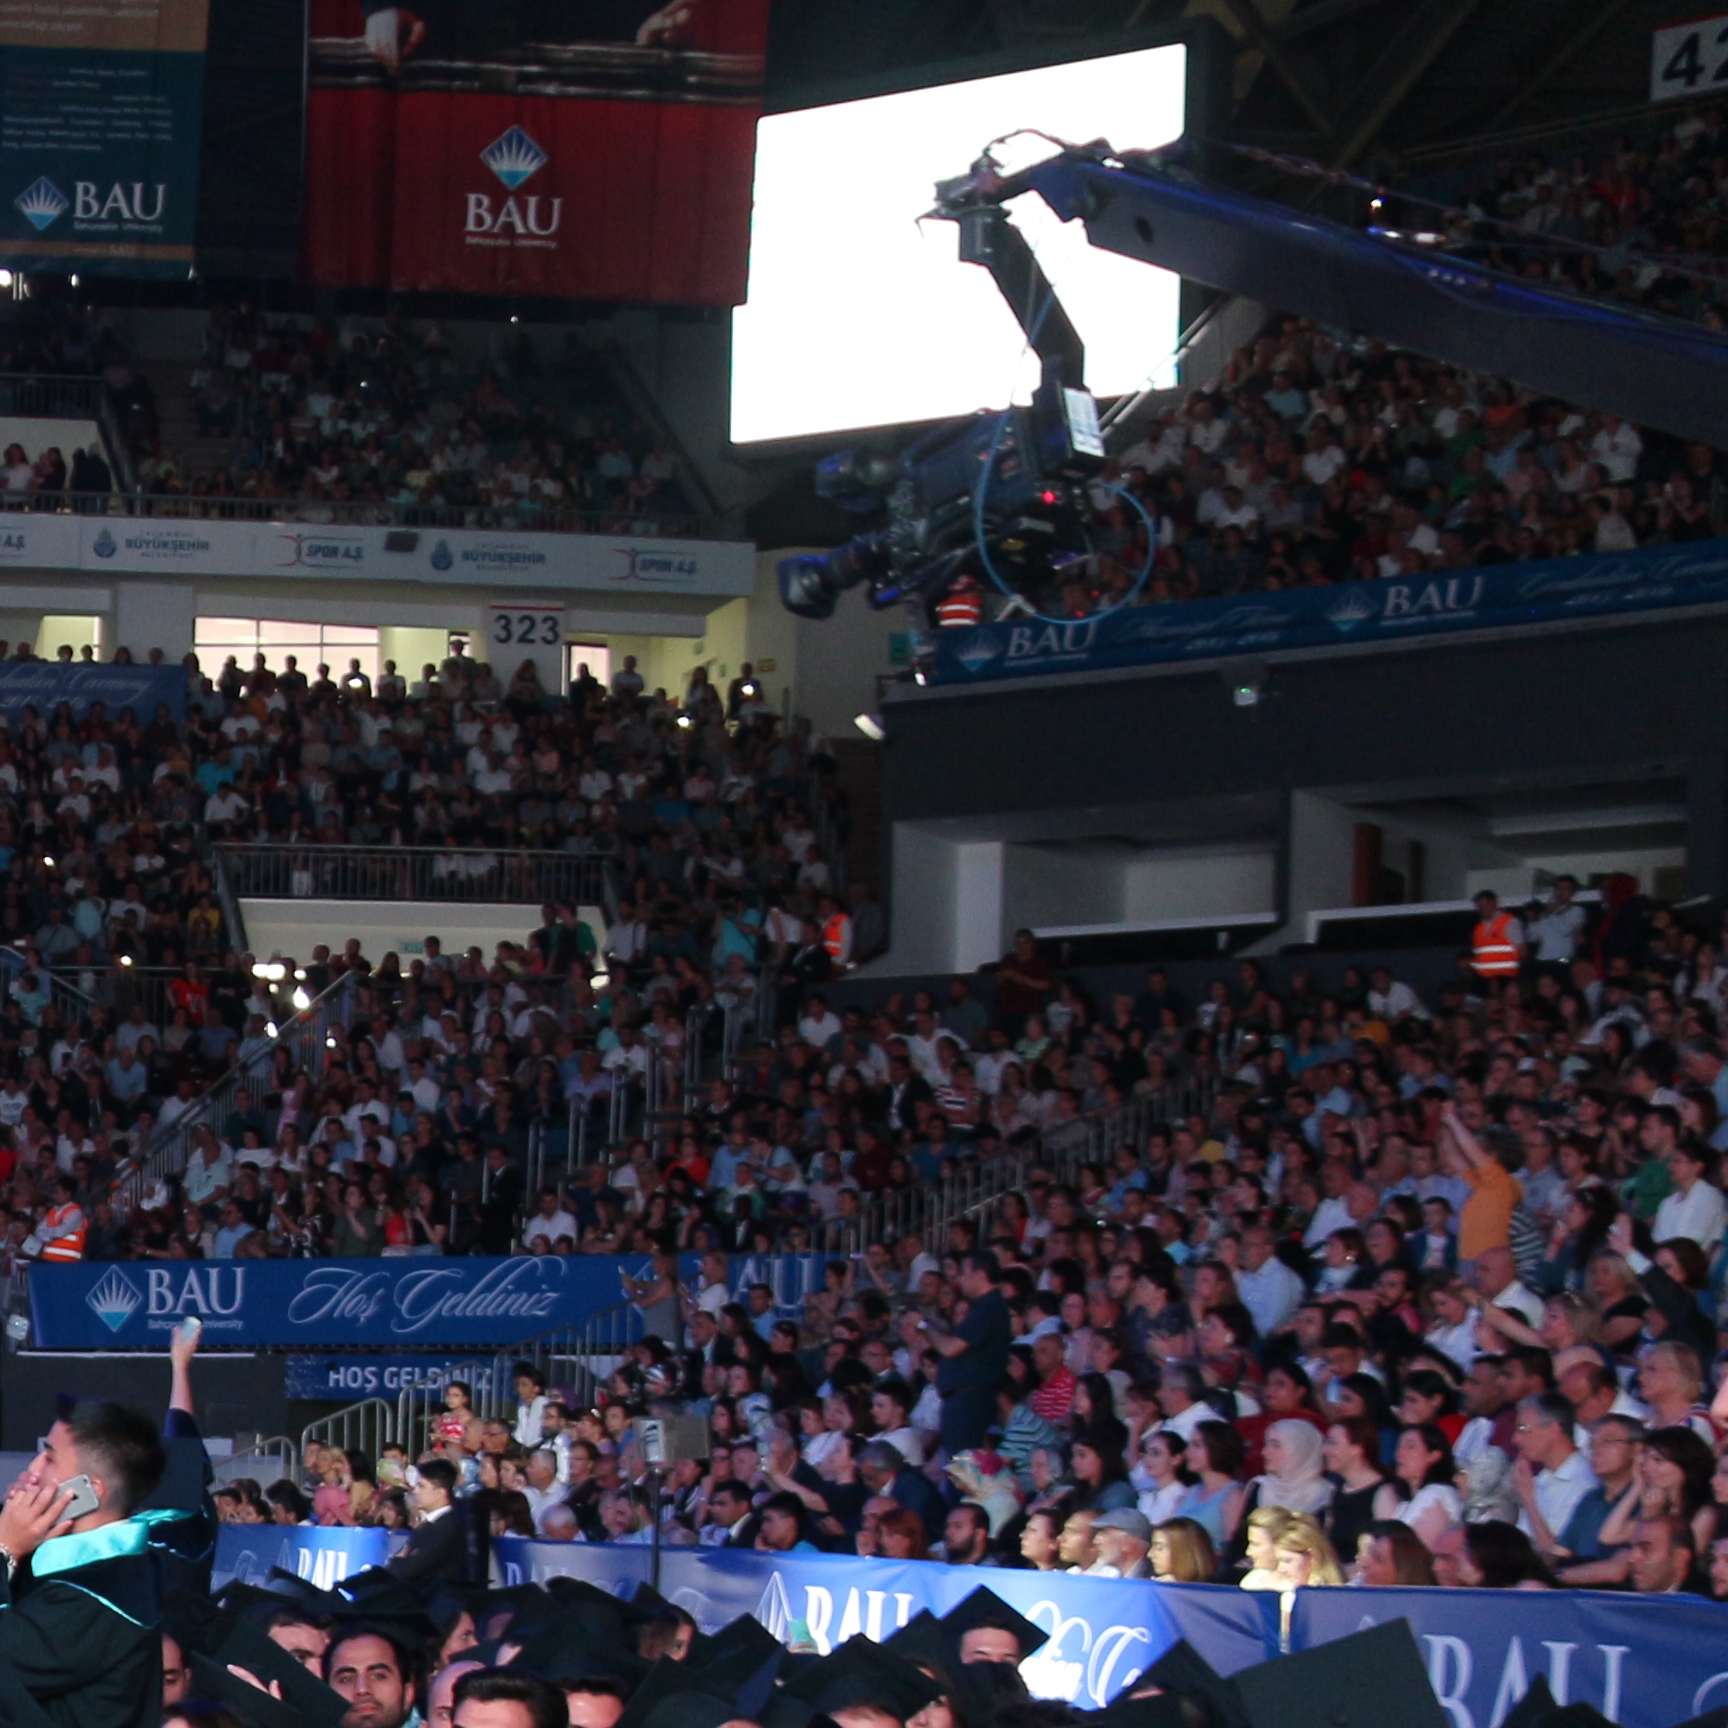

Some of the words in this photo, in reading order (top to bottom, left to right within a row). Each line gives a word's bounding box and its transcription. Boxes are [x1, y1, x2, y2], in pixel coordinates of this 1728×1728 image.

[74, 180, 166, 221] BAU
[464, 193, 565, 236] BAU
[307, 544, 339, 557] SPOR
[1384, 576, 1484, 617] BAU
[494, 614, 560, 645] 323
[1007, 624, 1098, 658] BAU
[144, 1267, 247, 1314] BAU
[288, 1266, 390, 1326] Hoş
[390, 1256, 568, 1333] Geldiniz
[329, 1364, 379, 1392] HOŞ
[383, 1361, 491, 1390] GELDİNZ
